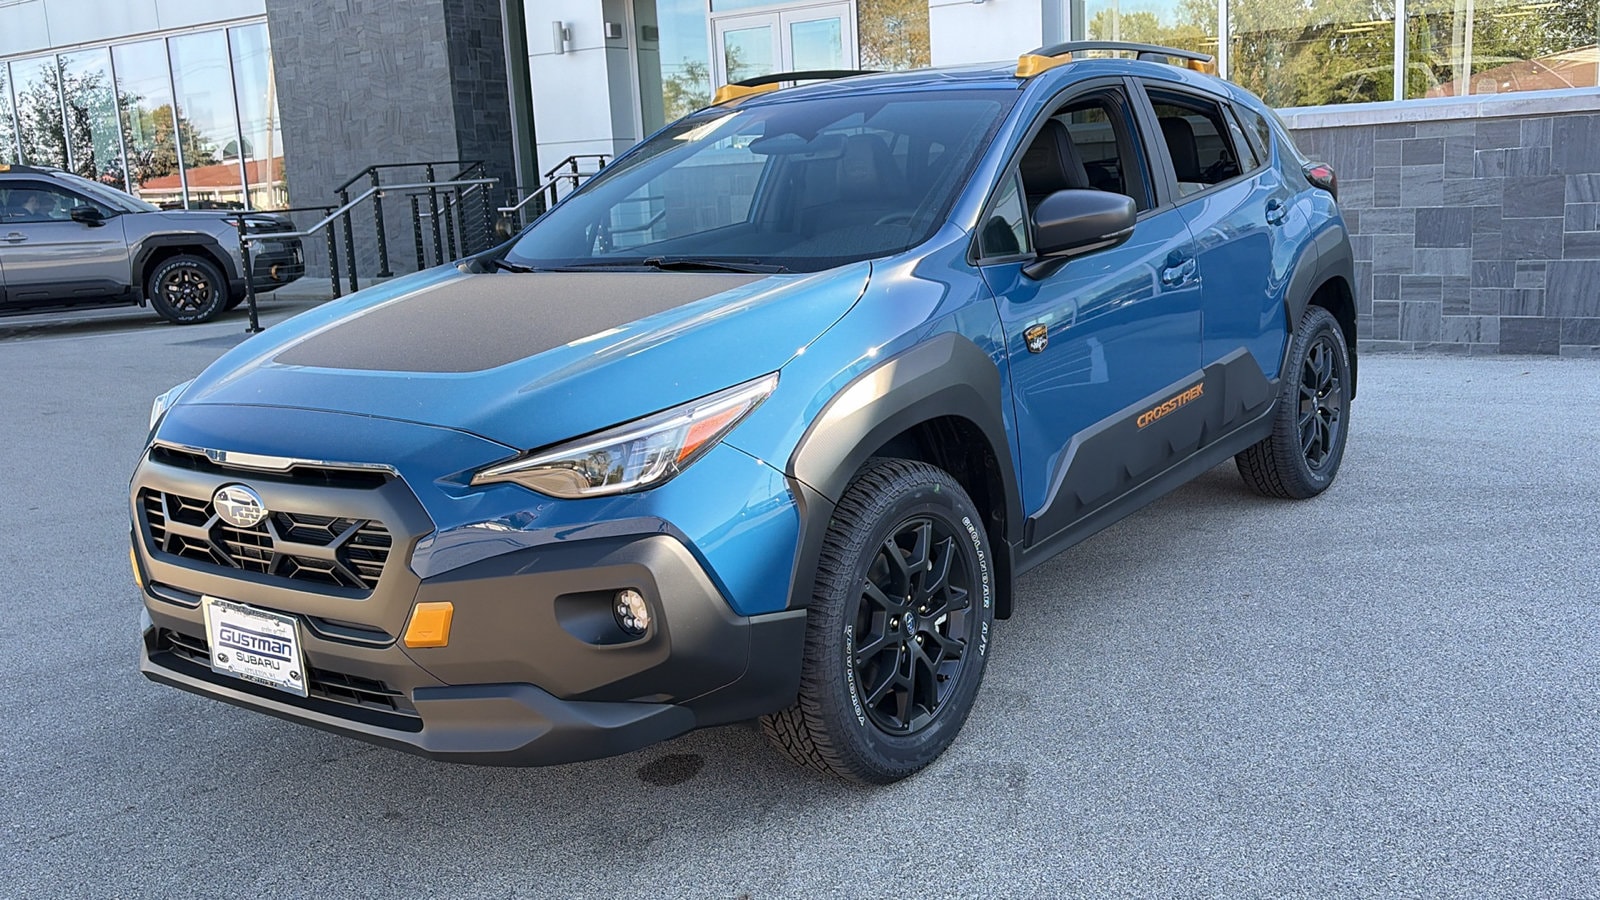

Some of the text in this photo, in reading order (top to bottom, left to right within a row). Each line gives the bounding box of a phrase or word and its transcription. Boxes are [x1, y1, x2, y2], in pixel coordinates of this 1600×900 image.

[1136, 382, 1204, 428] CROSSTREK
[962, 516, 990, 656] GEOLANDAR A/T
[236, 651, 280, 671] SUBARU
[846, 625, 866, 727] YOKOHAMA
